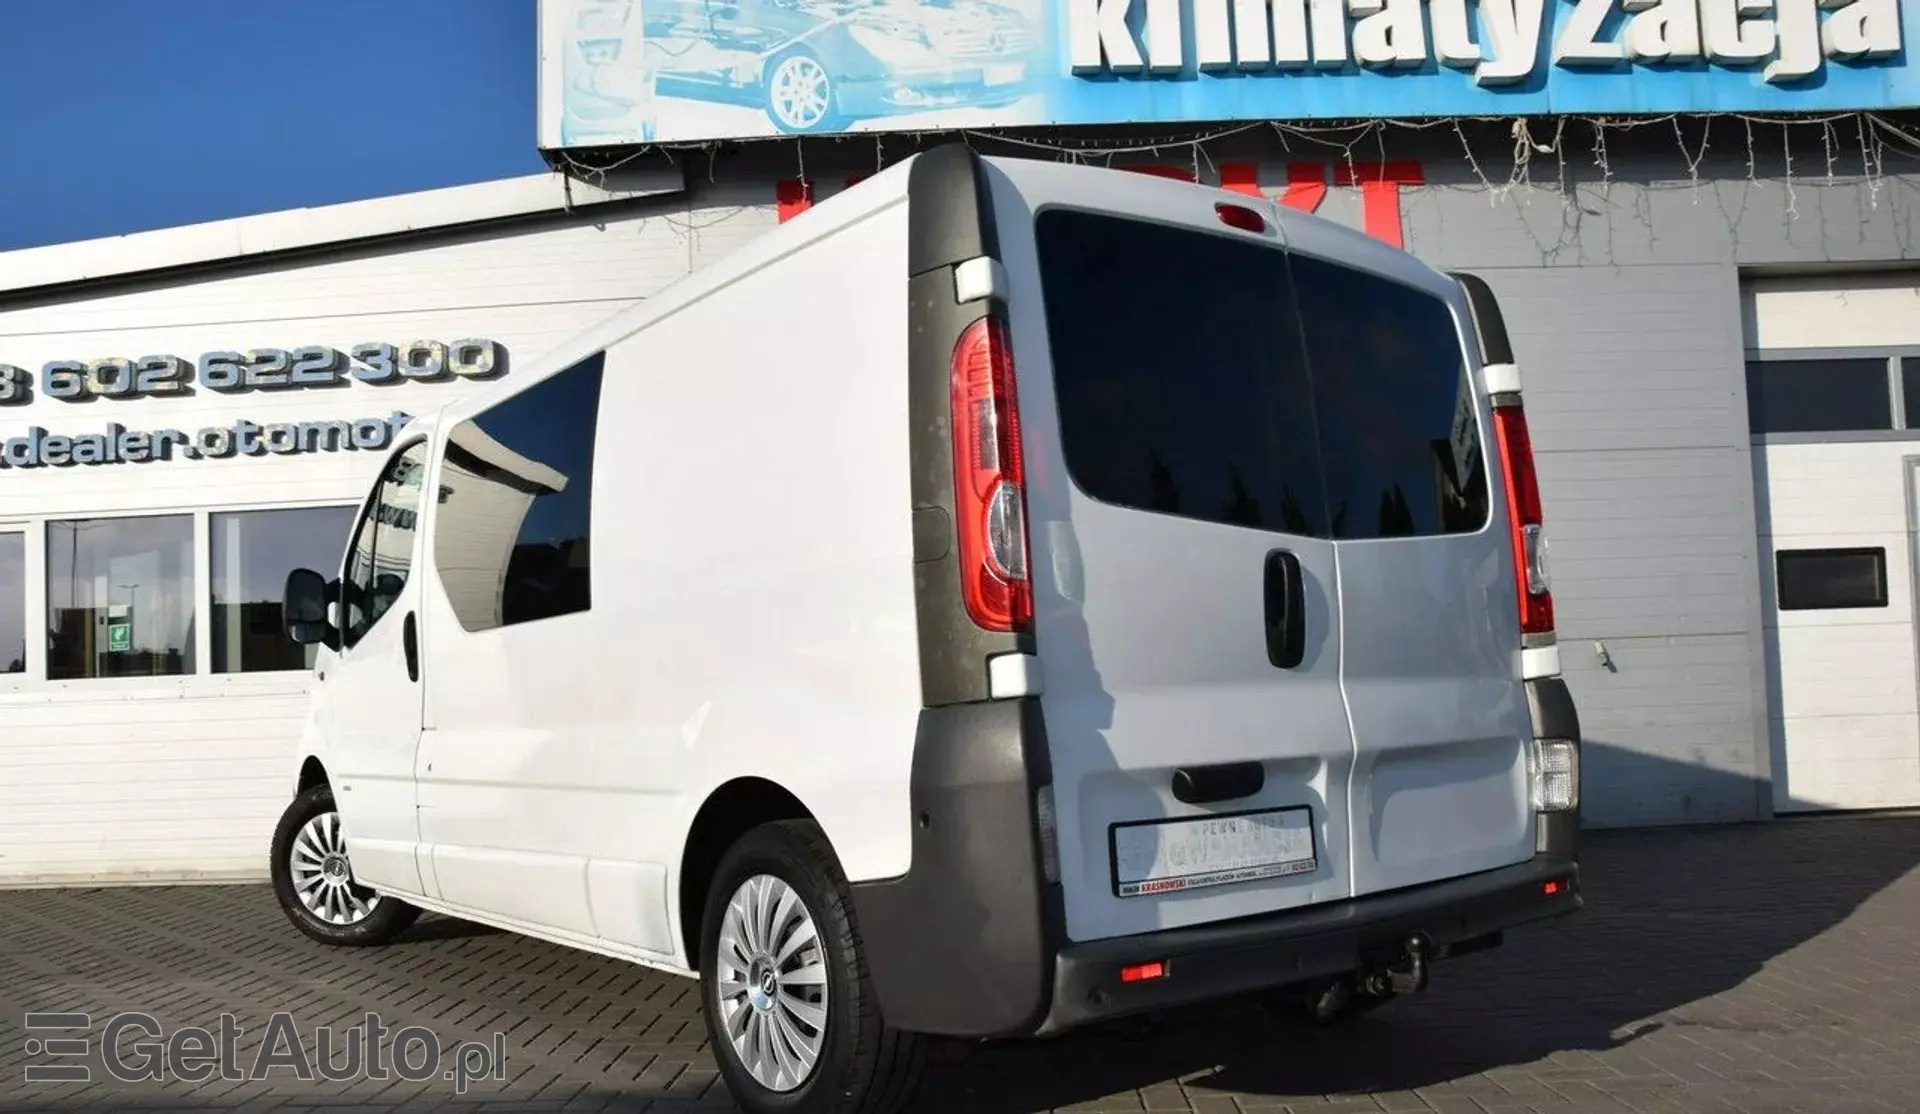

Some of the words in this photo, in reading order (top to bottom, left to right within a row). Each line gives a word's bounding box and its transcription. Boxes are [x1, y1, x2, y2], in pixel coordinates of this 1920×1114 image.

[42, 355, 188, 400] 602
[200, 345, 346, 393] 622
[350, 338, 506, 383] 300
[0, 409, 414, 468] dealer.otomot
